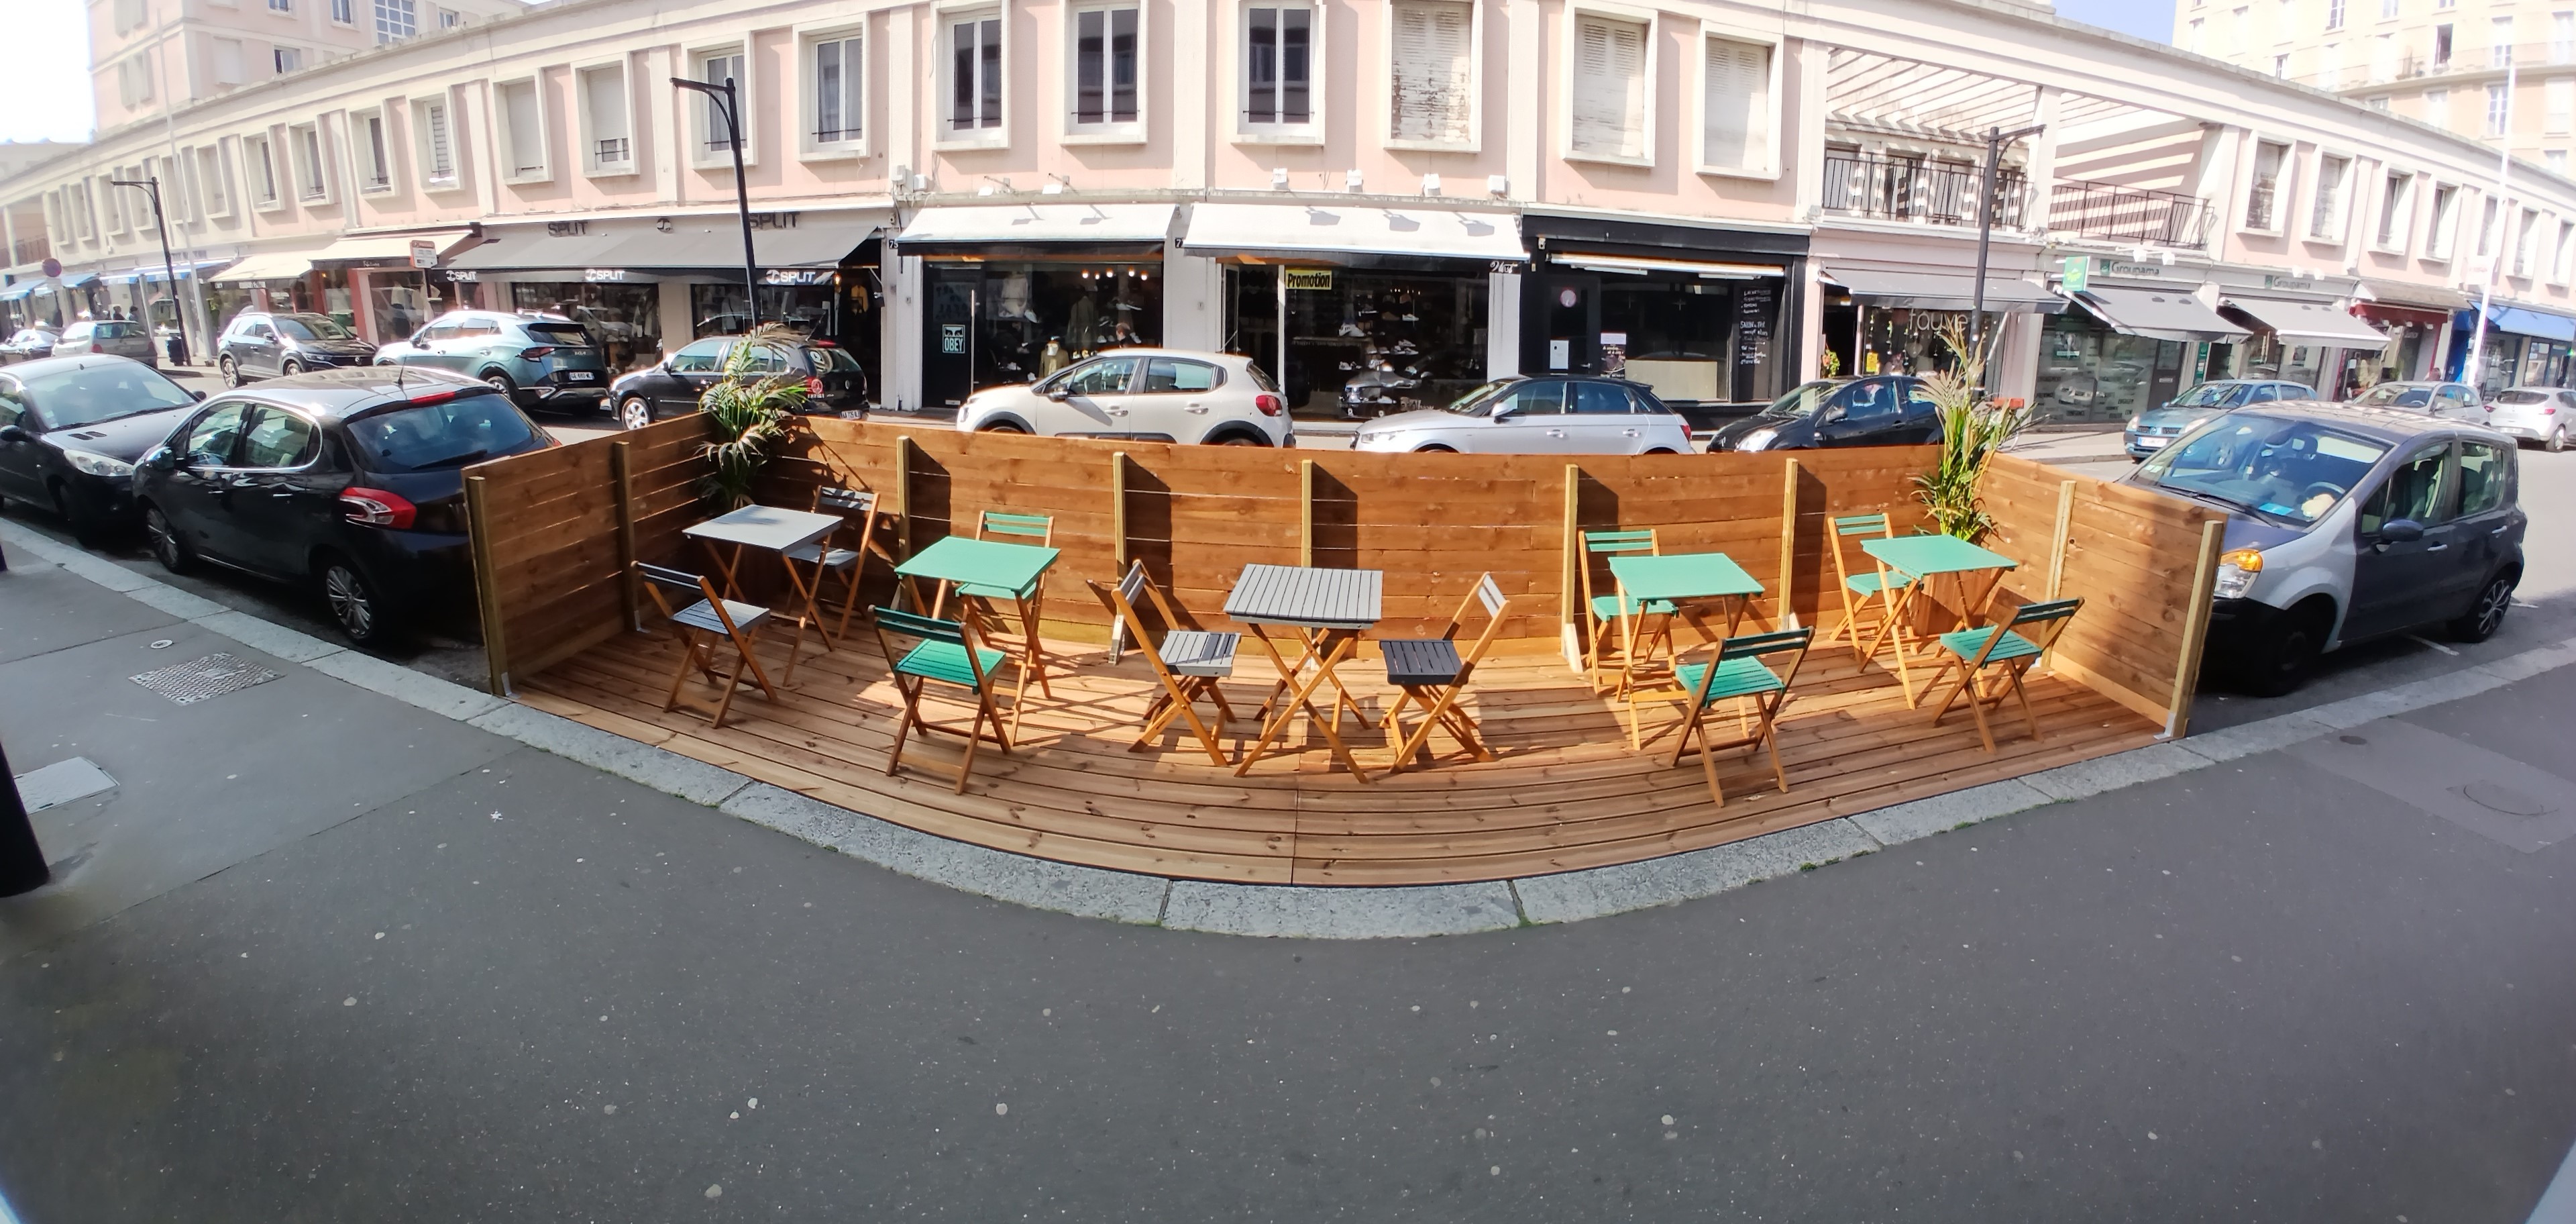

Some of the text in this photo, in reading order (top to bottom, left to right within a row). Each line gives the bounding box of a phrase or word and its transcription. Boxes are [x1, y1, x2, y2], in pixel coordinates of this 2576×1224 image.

[749, 211, 800, 230] SPLIT
[548, 221, 588, 236] SPLIT
[890, 240, 899, 249] 75
[596, 270, 625, 280] SPLIT
[2112, 262, 2159, 275] Groupama
[455, 271, 477, 280] SPLIT
[780, 271, 816, 283] SPLIT
[1287, 272, 1330, 287] Promotion
[944, 338, 963, 352] OBEY
